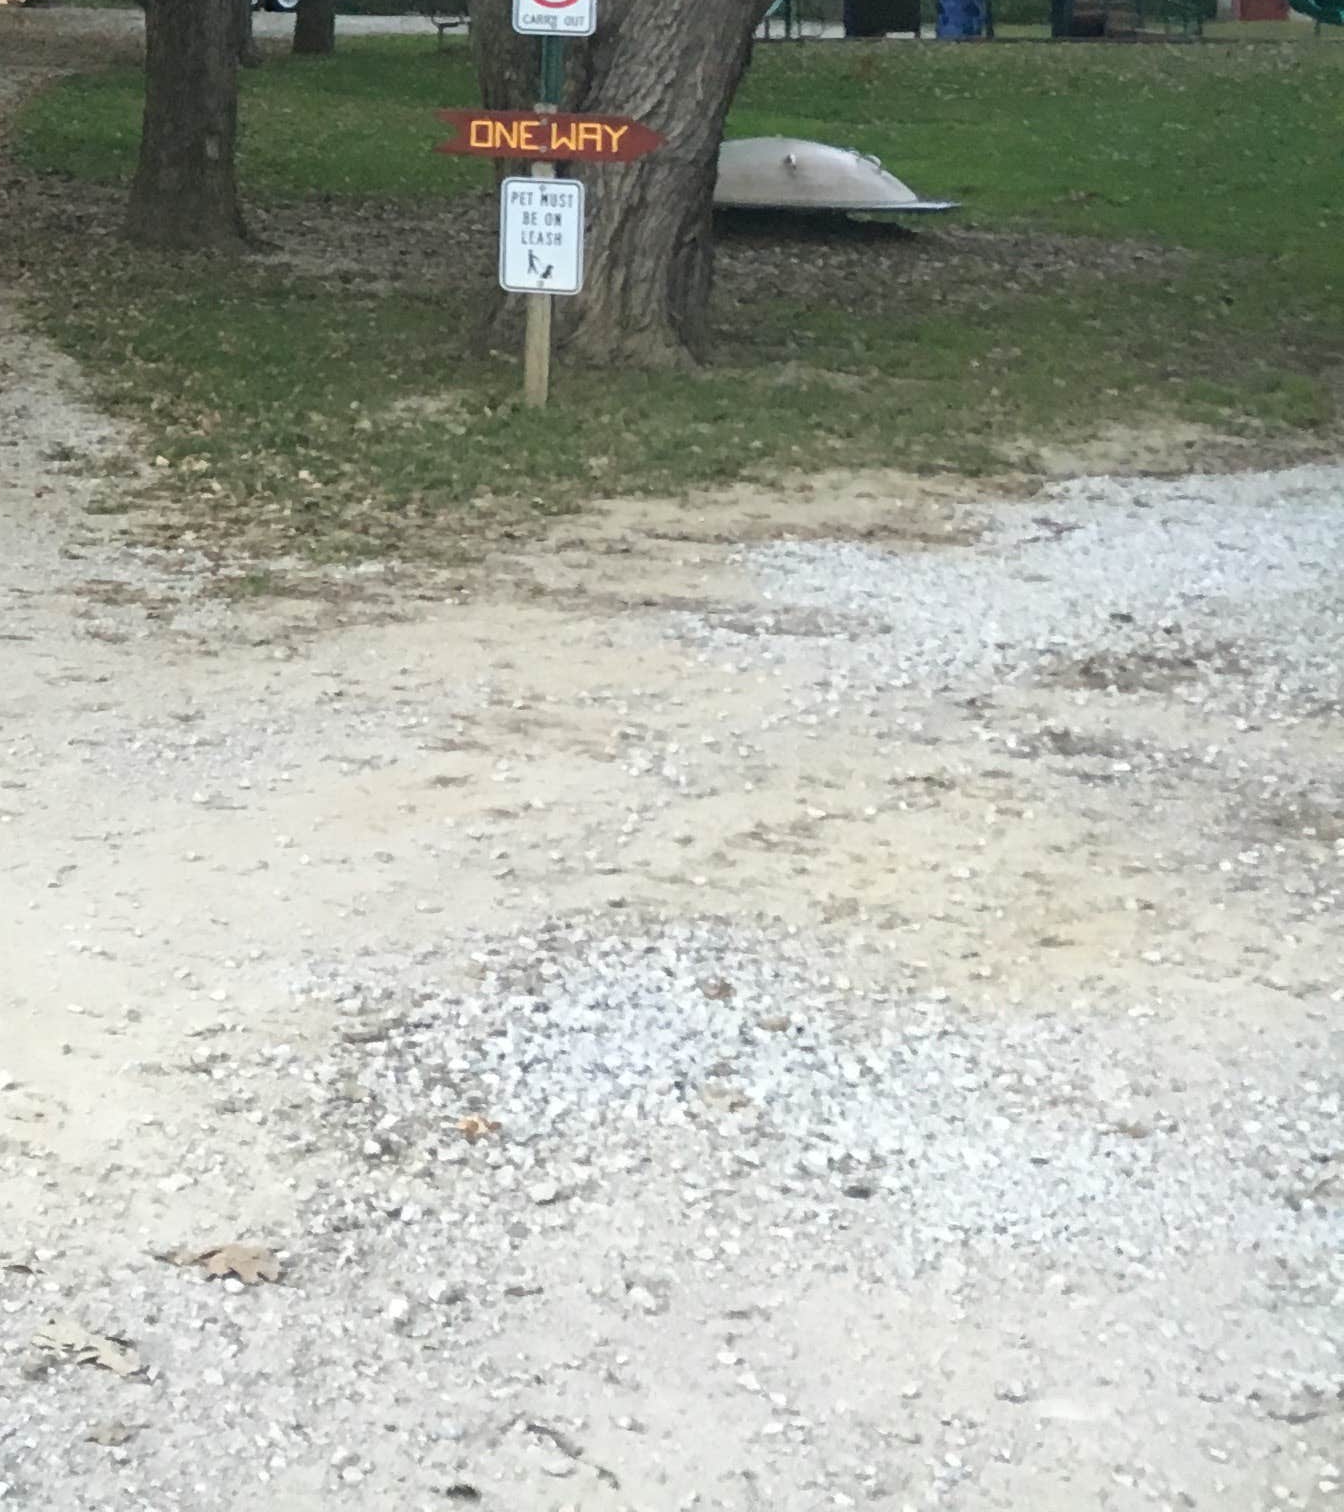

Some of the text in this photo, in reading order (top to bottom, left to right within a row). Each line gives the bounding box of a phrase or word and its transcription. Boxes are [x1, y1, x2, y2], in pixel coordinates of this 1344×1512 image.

[522, 14, 585, 27] CARRY OUT
[470, 120, 628, 153] ONE WAY
[510, 192, 575, 208] PET MUST
[522, 212, 562, 226] BE ON
[521, 231, 562, 246] LEASH
